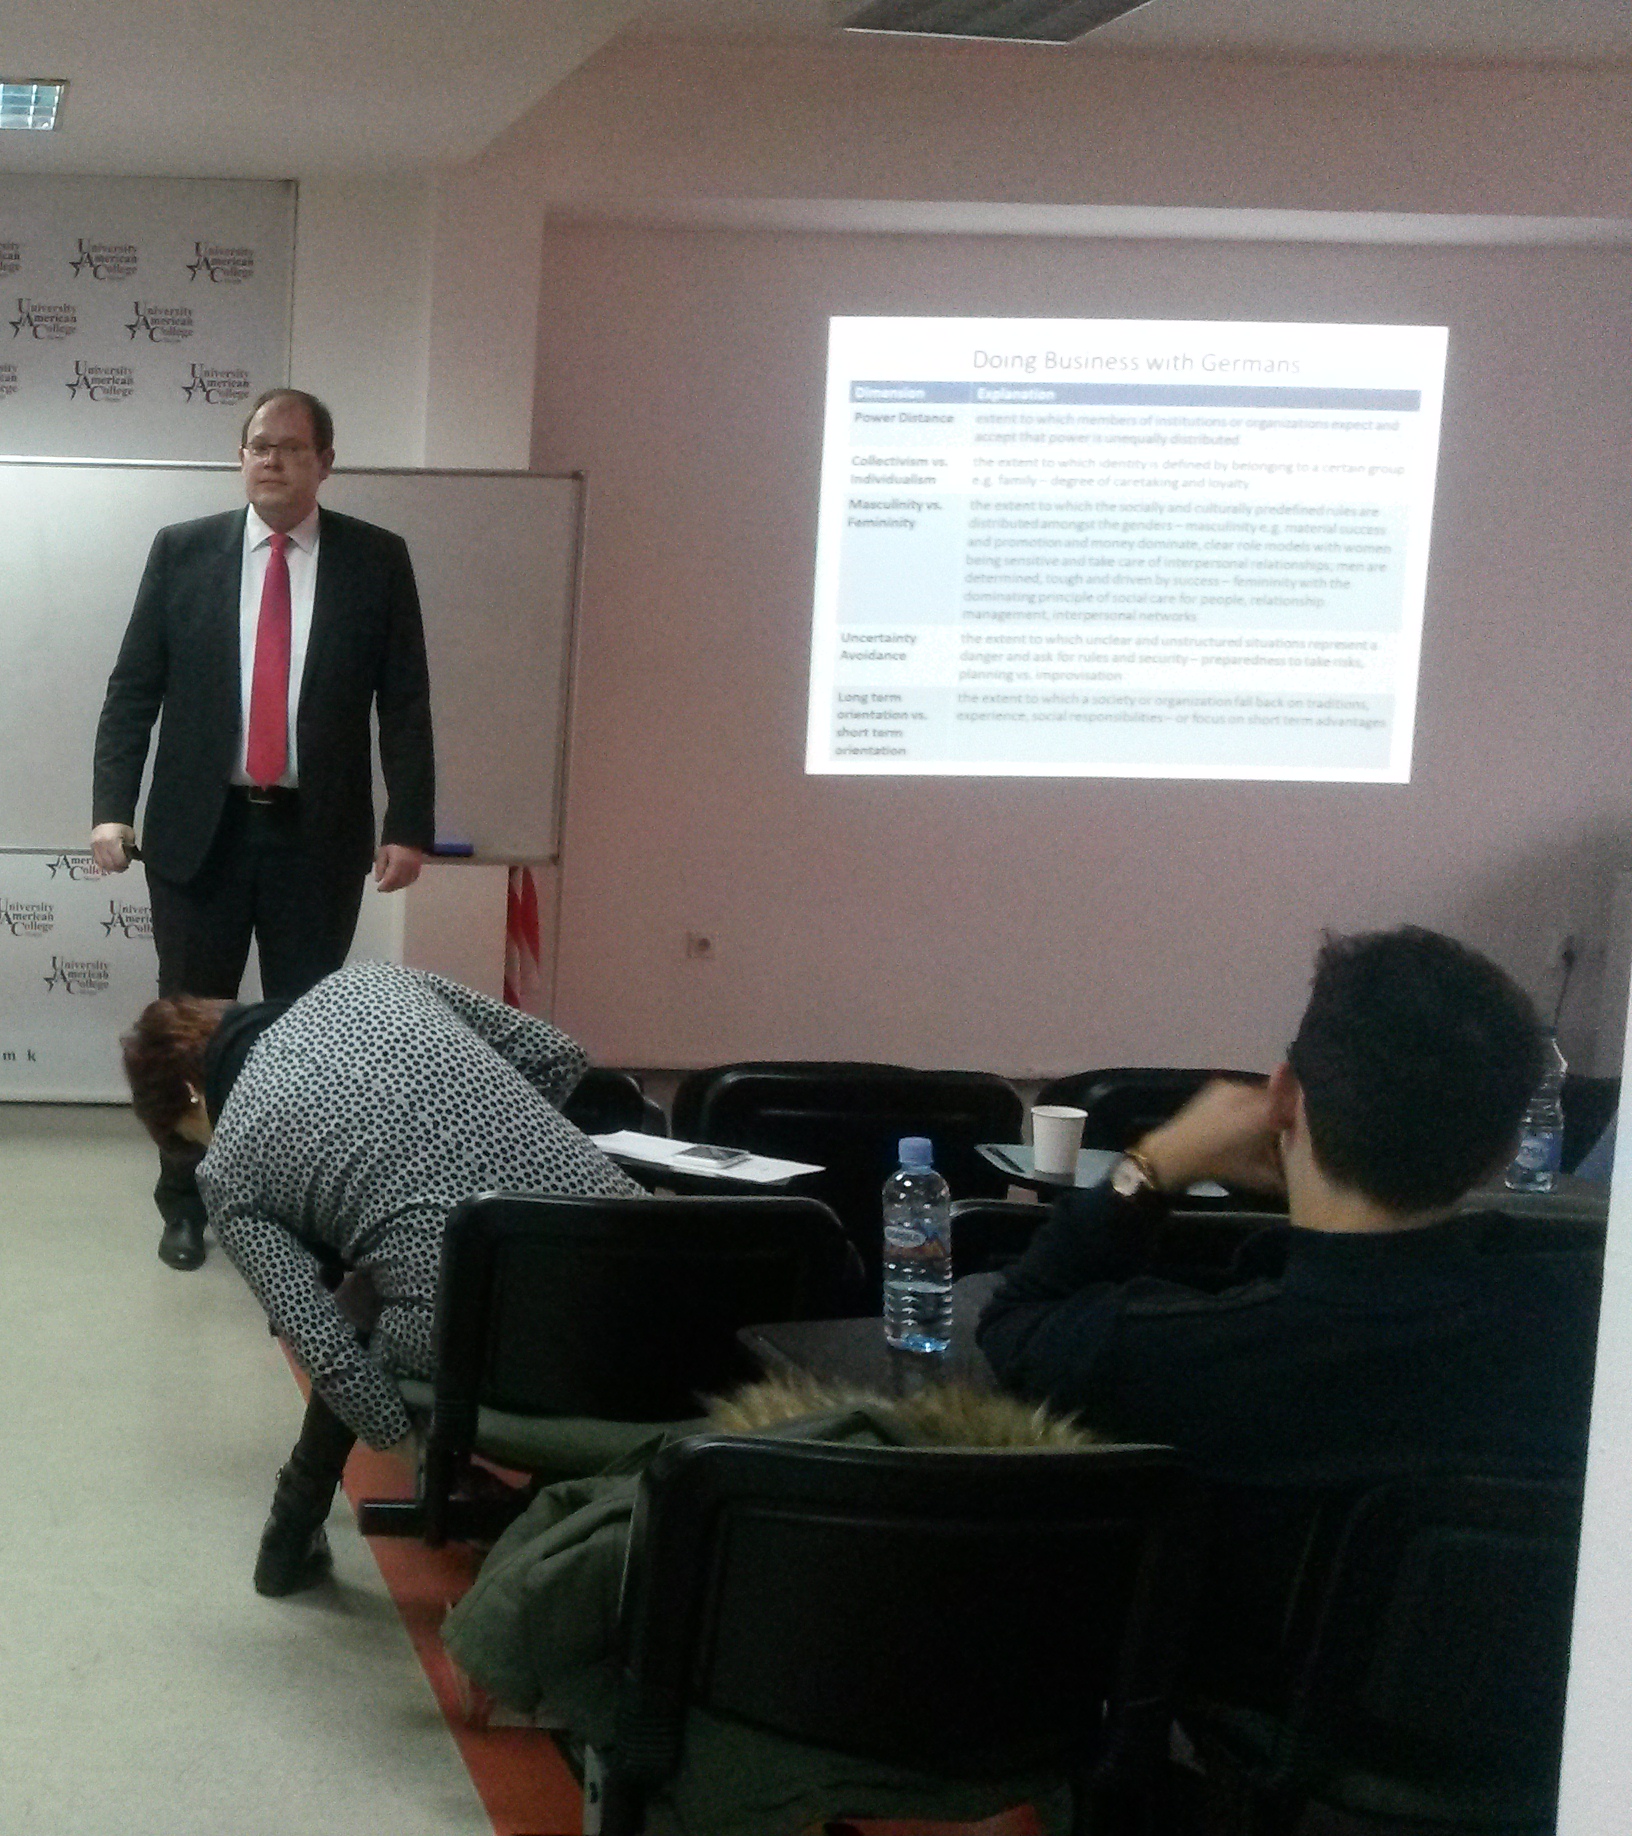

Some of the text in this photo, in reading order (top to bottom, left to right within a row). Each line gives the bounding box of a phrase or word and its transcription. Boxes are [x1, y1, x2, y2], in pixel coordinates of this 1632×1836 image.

[78, 238, 137, 254] University
[194, 242, 254, 257] University
[82, 253, 137, 267] American
[200, 256, 254, 270] American
[94, 264, 137, 280] College
[210, 267, 254, 282] College
[18, 298, 77, 314] University
[134, 302, 193, 317] University
[22, 313, 77, 327] American
[138, 316, 193, 329] American
[34, 324, 77, 340] College
[150, 327, 193, 342] College
[74, 360, 134, 376] University
[973, 351, 1300, 374] Doing Business with Germans
[190, 363, 249, 379] University
[80, 375, 134, 388] American
[196, 378, 249, 391] American
[90, 385, 134, 400] College
[206, 389, 249, 404] College
[855, 412, 954, 423] Power Distance
[852, 455, 928, 467] Collectivism
[848, 499, 921, 513] Masculinity
[840, 633, 917, 646] Uncertainty
[840, 650, 906, 661] Avoidance
[838, 692, 868, 705] Long
[58, 855, 95, 869] Ameri
[1, 912, 54, 925] American
[12, 922, 54, 936] College
[52, 956, 109, 971] University
[56, 970, 109, 983] American
[68, 980, 109, 995] College
